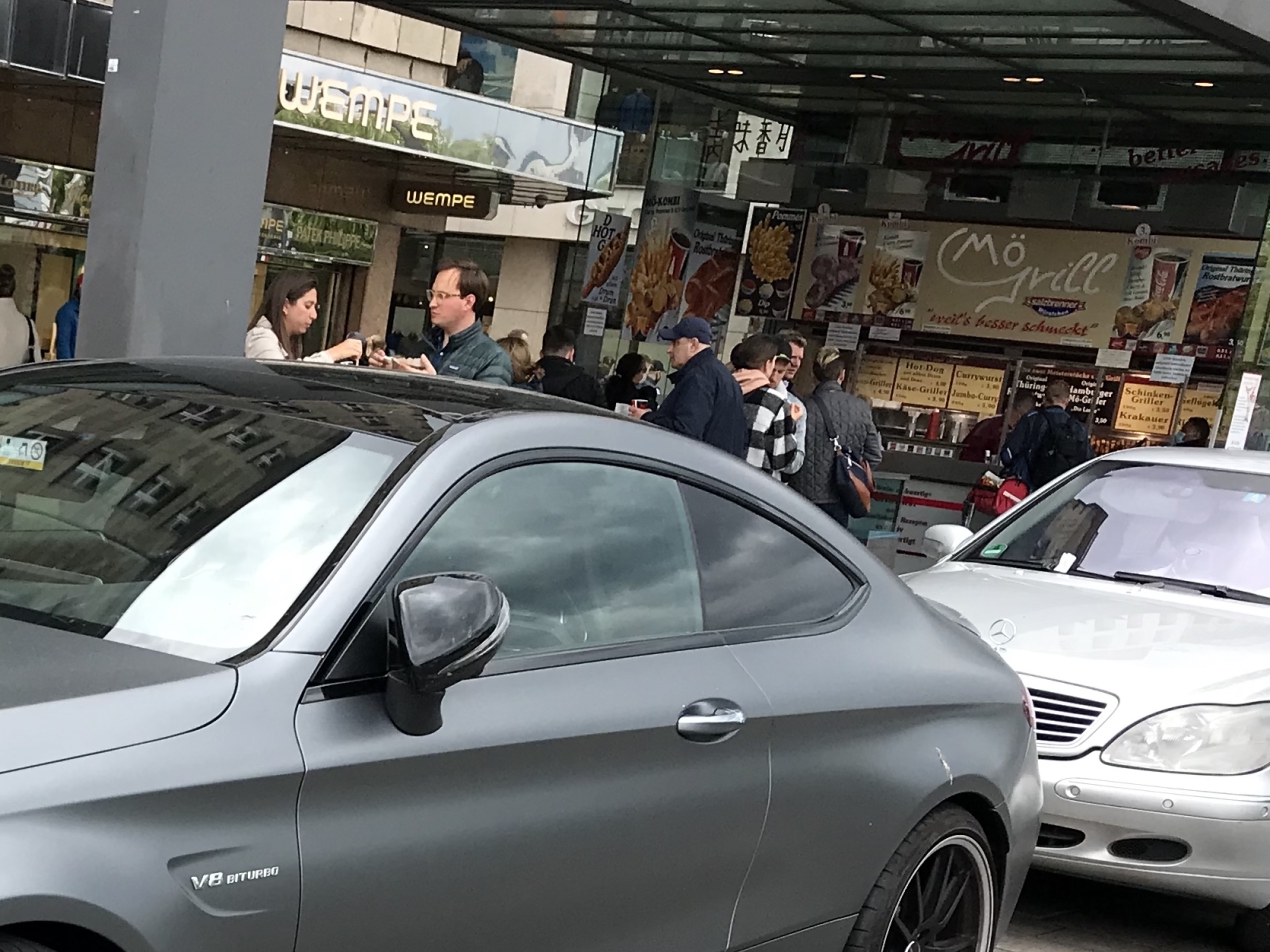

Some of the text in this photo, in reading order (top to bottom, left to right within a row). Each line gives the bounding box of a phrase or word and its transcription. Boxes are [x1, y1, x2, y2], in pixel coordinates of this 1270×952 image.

[279, 68, 438, 141] WEMPE
[406, 190, 476, 209] WEMPE
[296, 226, 322, 242] PATEK
[323, 230, 362, 249] PHILIPPE
[953, 233, 1026, 268] Mö
[975, 313, 1020, 331] besser
[955, 370, 1002, 383] Currywurst
[896, 382, 947, 397] Käse-Griller
[951, 389, 998, 403] Jumbo-Curry
[1124, 387, 1174, 399] Schinken-
[1131, 395, 1164, 407] Griller
[1119, 411, 1169, 424] Krakauer
[191, 866, 279, 890] V8 BITURBO
